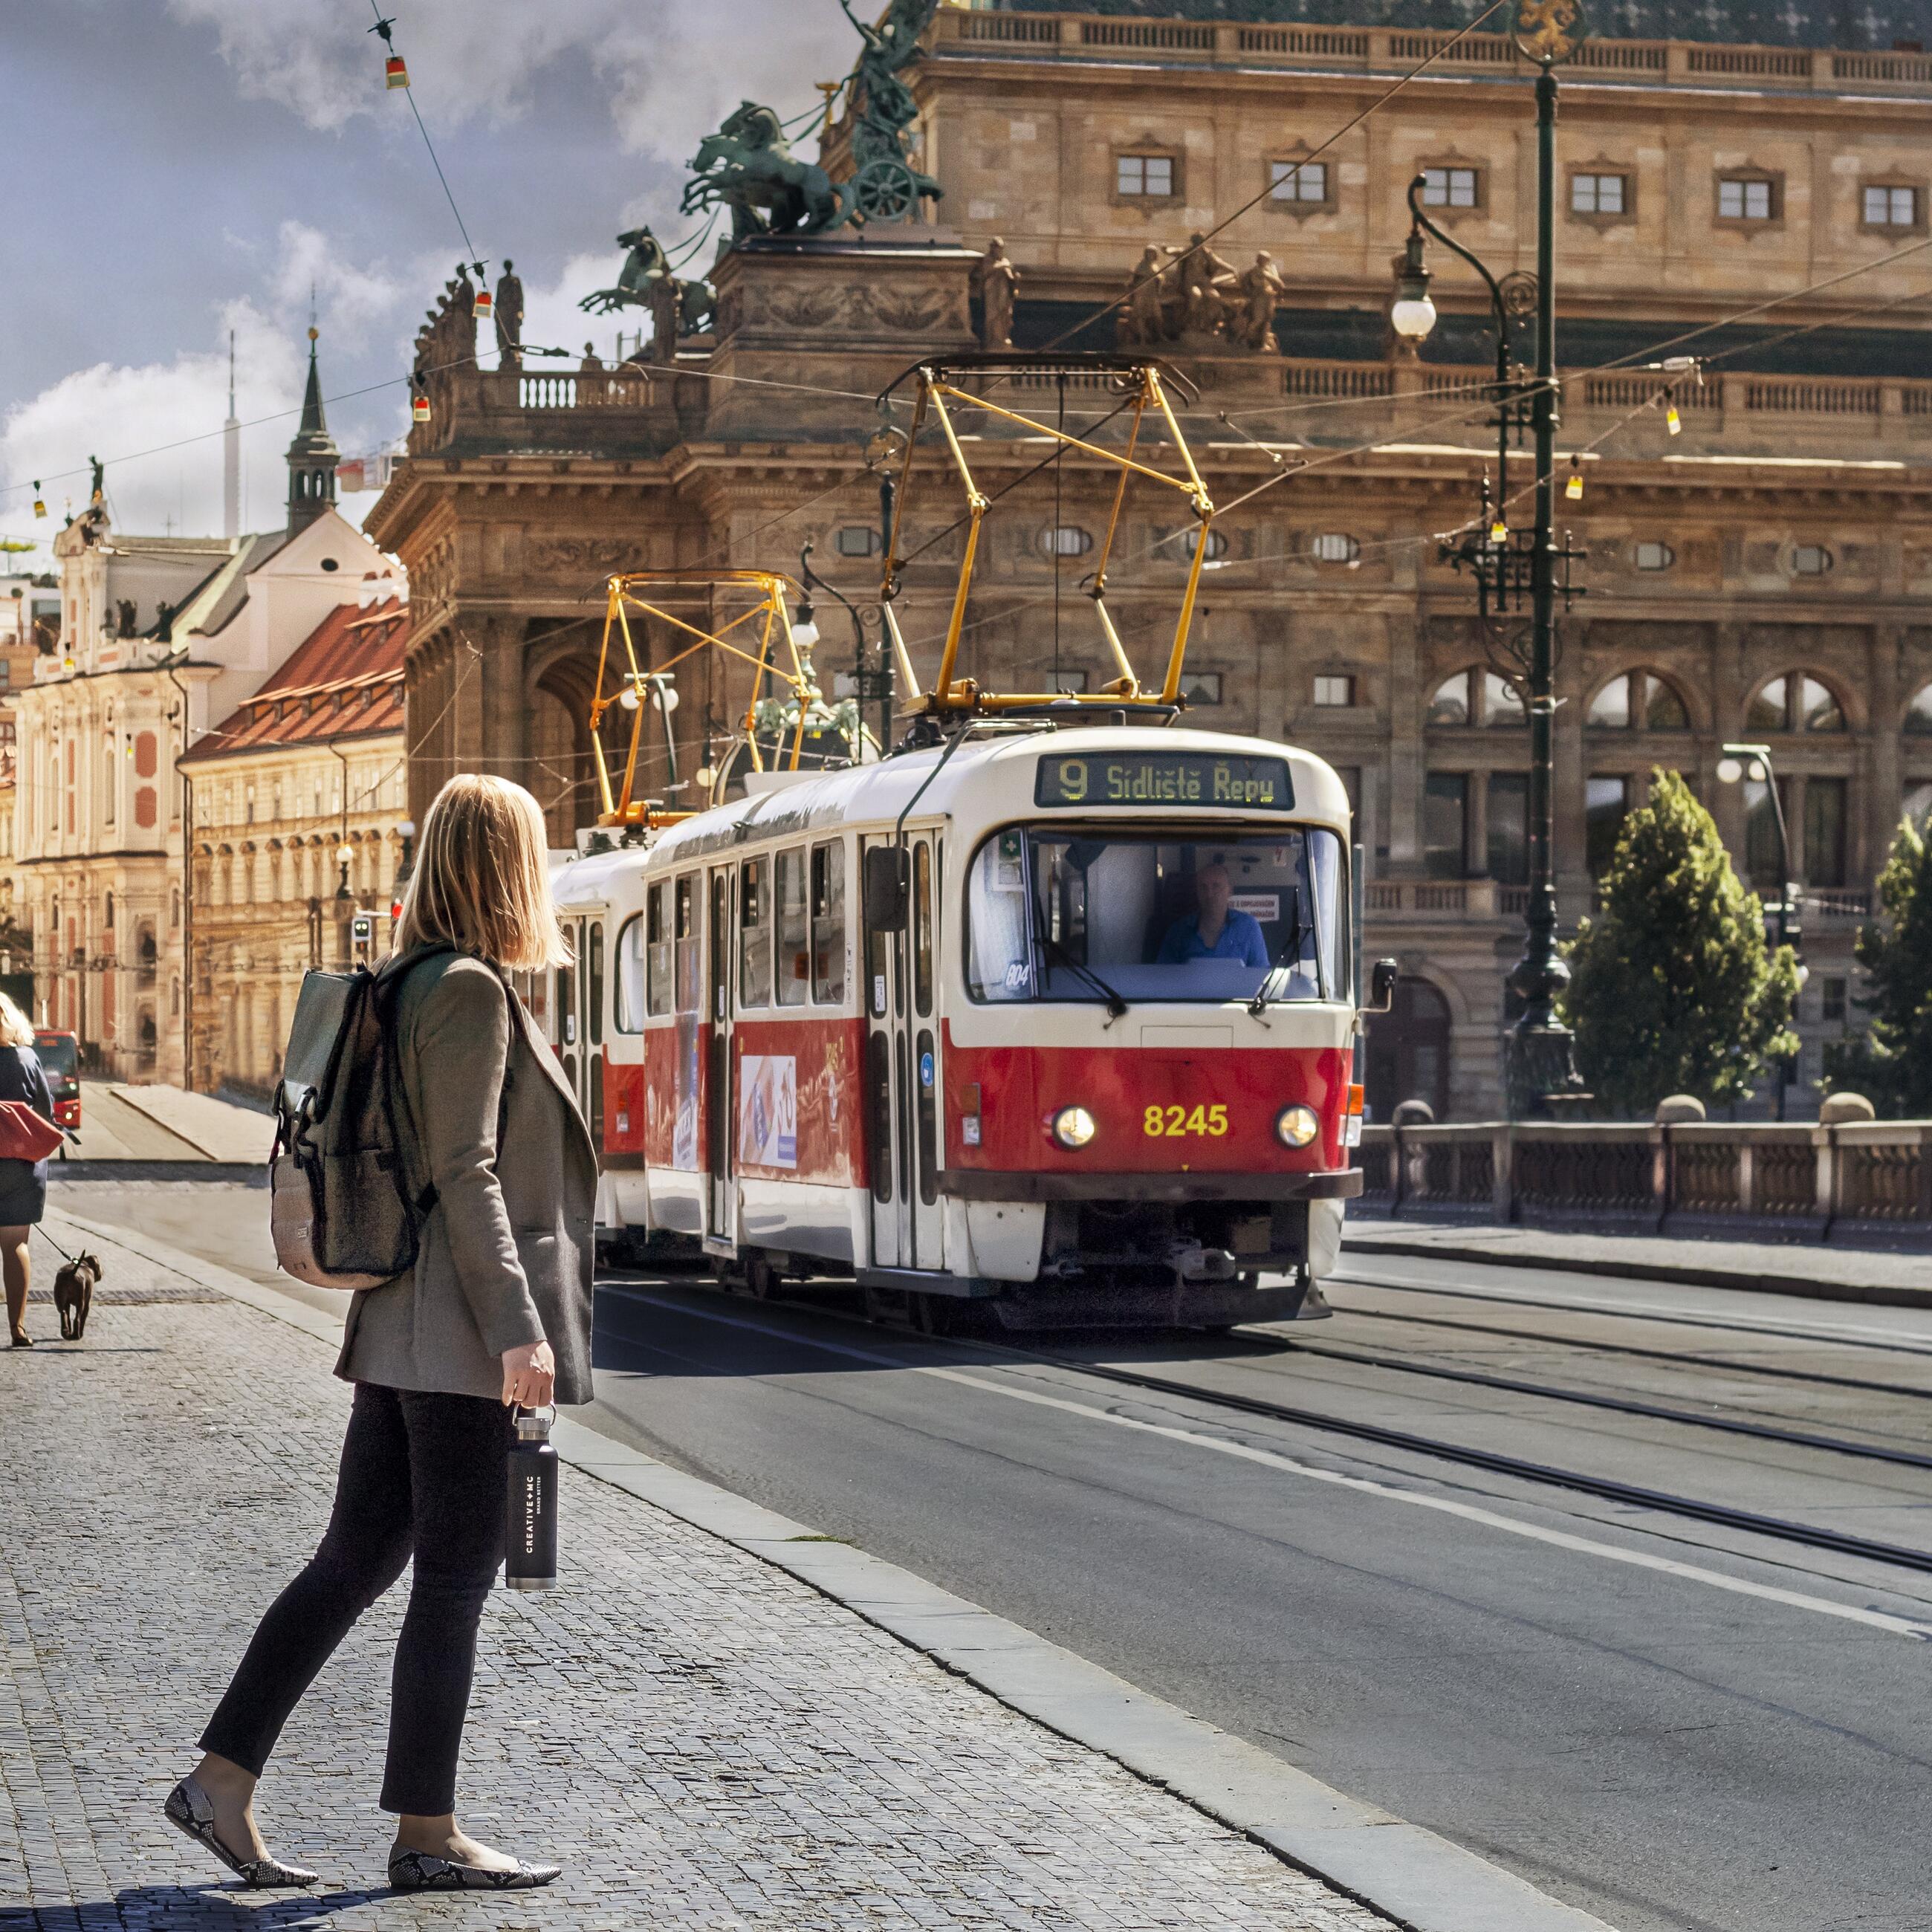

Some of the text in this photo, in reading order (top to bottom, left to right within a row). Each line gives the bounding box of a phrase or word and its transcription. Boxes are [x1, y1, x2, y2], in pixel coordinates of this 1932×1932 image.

[1060, 758, 1088, 800] 9
[1144, 1104, 1228, 1137] 8245
[526, 1476, 534, 1491] MC
